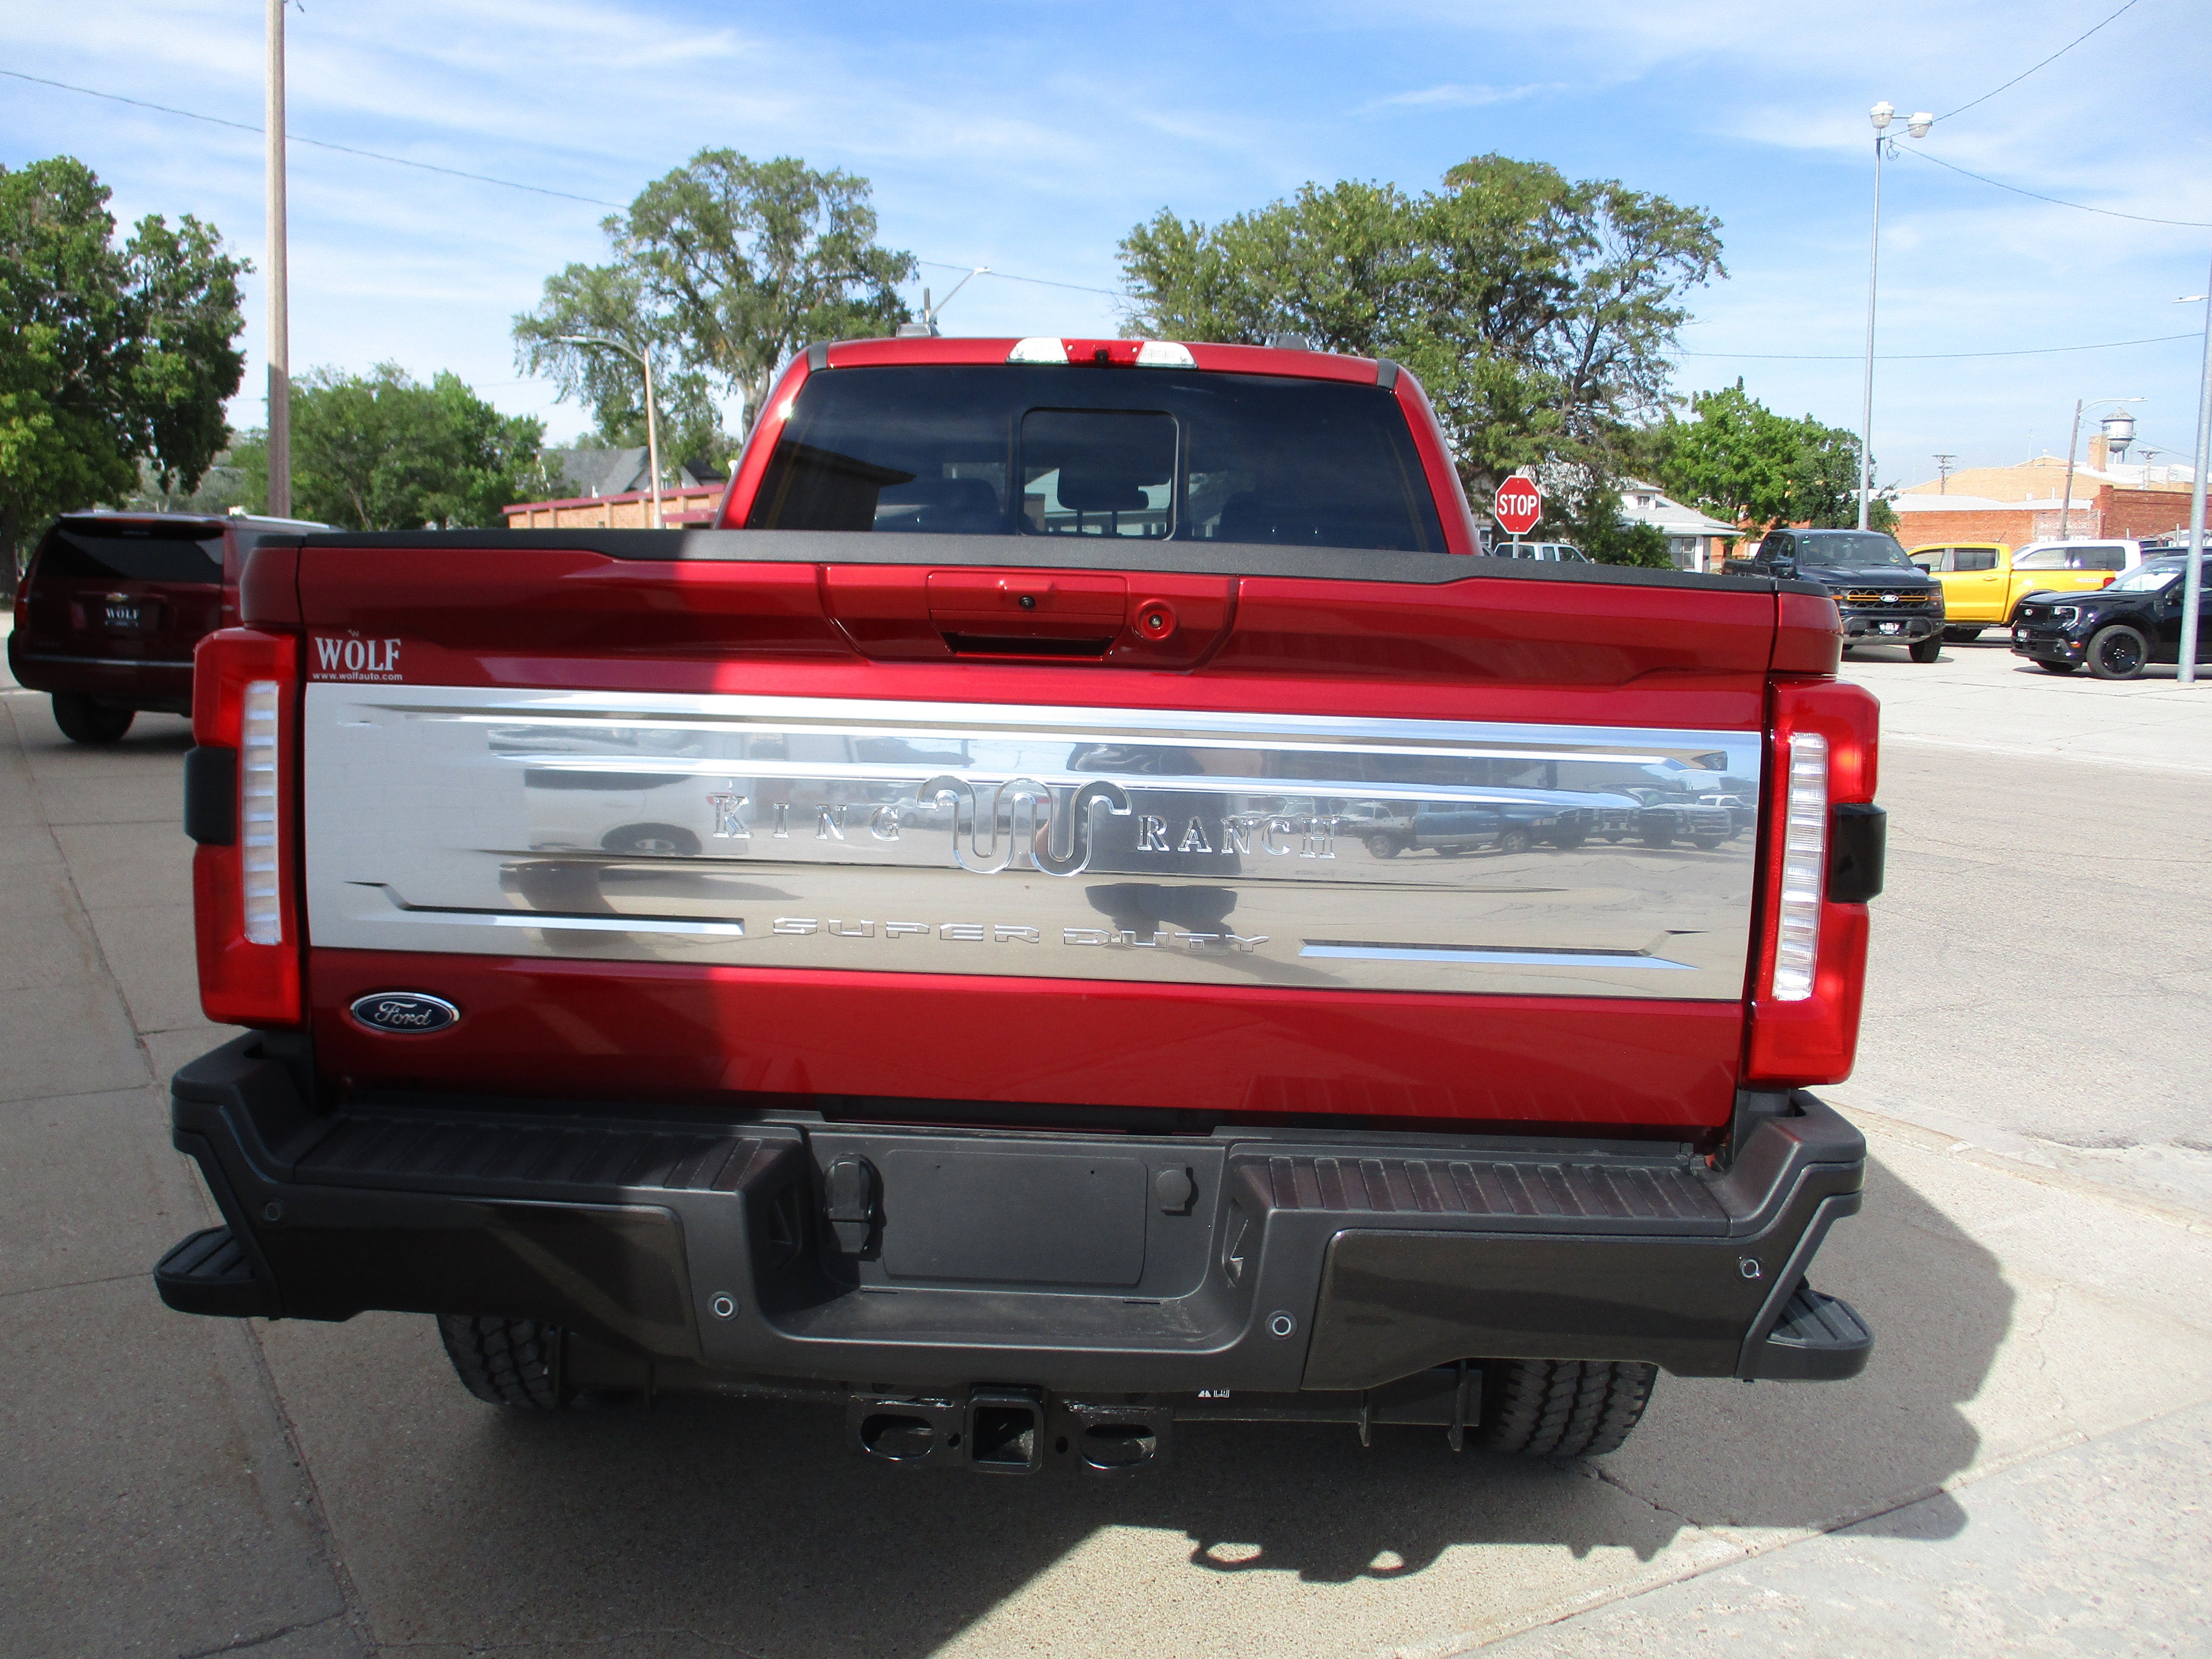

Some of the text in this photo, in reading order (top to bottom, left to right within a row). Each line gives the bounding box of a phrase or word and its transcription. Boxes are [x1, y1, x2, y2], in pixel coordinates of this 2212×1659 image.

[1498, 494, 1537, 516] STOP
[315, 637, 402, 671] WOLF
[312, 672, 403, 681] www.wolfauto.com
[713, 795, 1339, 859] KING RANCH
[774, 917, 1269, 952] SUPER DUTY
[374, 1001, 432, 1026] Ford
